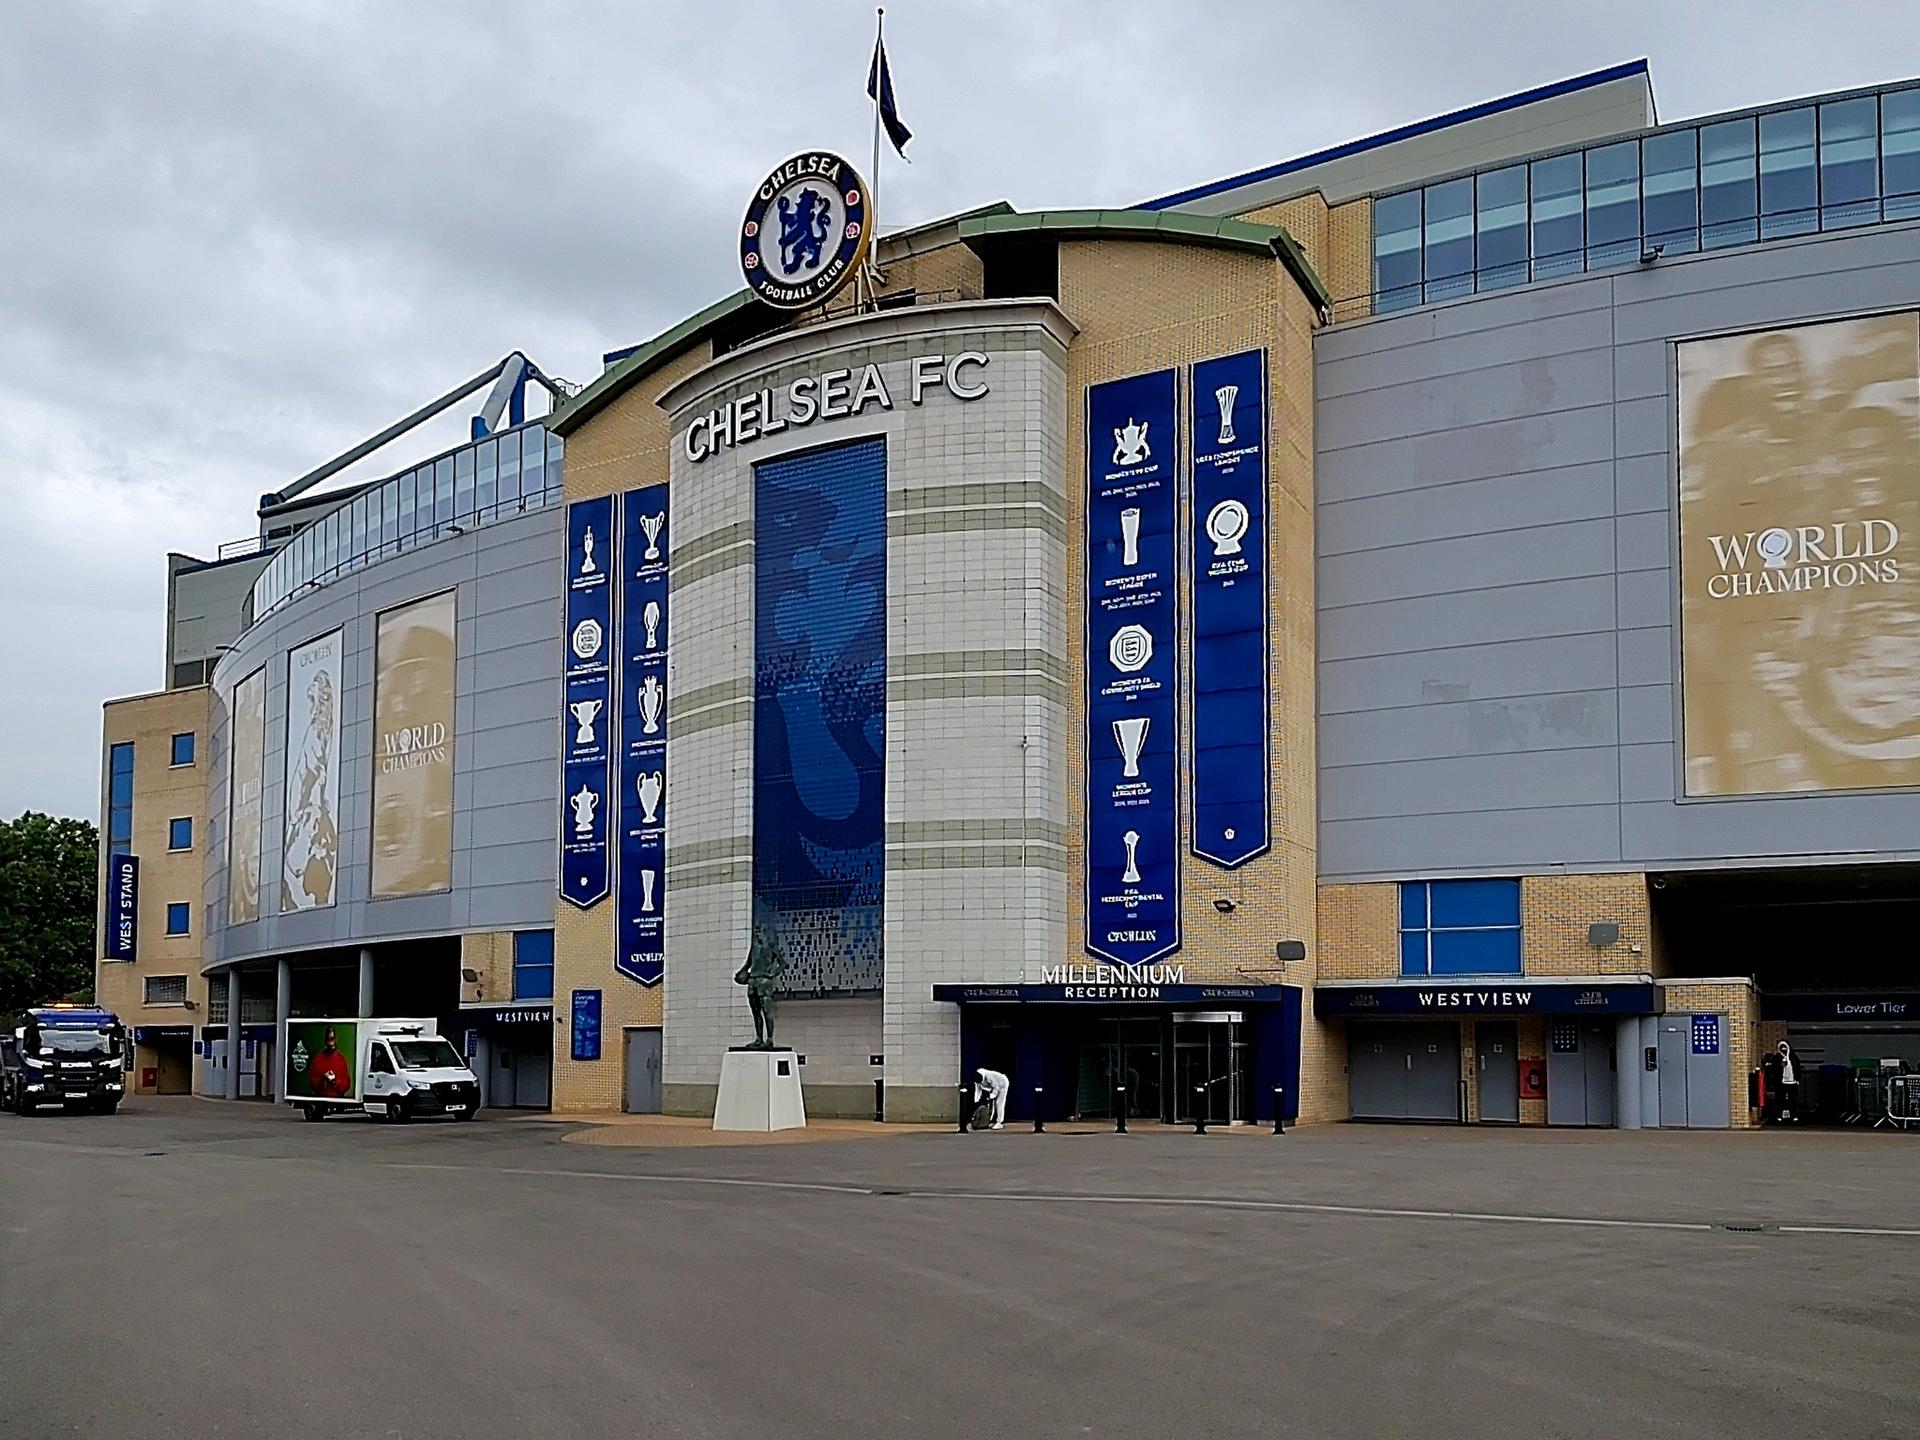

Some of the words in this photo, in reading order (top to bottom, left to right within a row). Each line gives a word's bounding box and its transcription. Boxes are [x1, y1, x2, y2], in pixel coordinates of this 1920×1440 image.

[760, 156, 840, 200] CHELSEA
[758, 280, 812, 301] FOOTBALL
[817, 258, 845, 289] CLUB
[685, 362, 893, 463] CHELSEA
[911, 351, 990, 405] FC
[1707, 518, 1899, 572] WORLD
[1707, 558, 1900, 599] CHAMPIONS
[384, 722, 445, 755] WORLD
[382, 747, 446, 774] CHAMPIONS
[121, 863, 134, 909] STAND
[119, 912, 133, 951] WEST
[1041, 965, 1184, 984] MILLENNIUM
[1064, 986, 1160, 999] RECEPTION
[496, 1011, 550, 1023] WESTVIEW
[1418, 992, 1532, 1006] WESTVIEW
[1836, 1002, 1876, 1014] Lower
[1880, 1001, 1907, 1014] Tier
